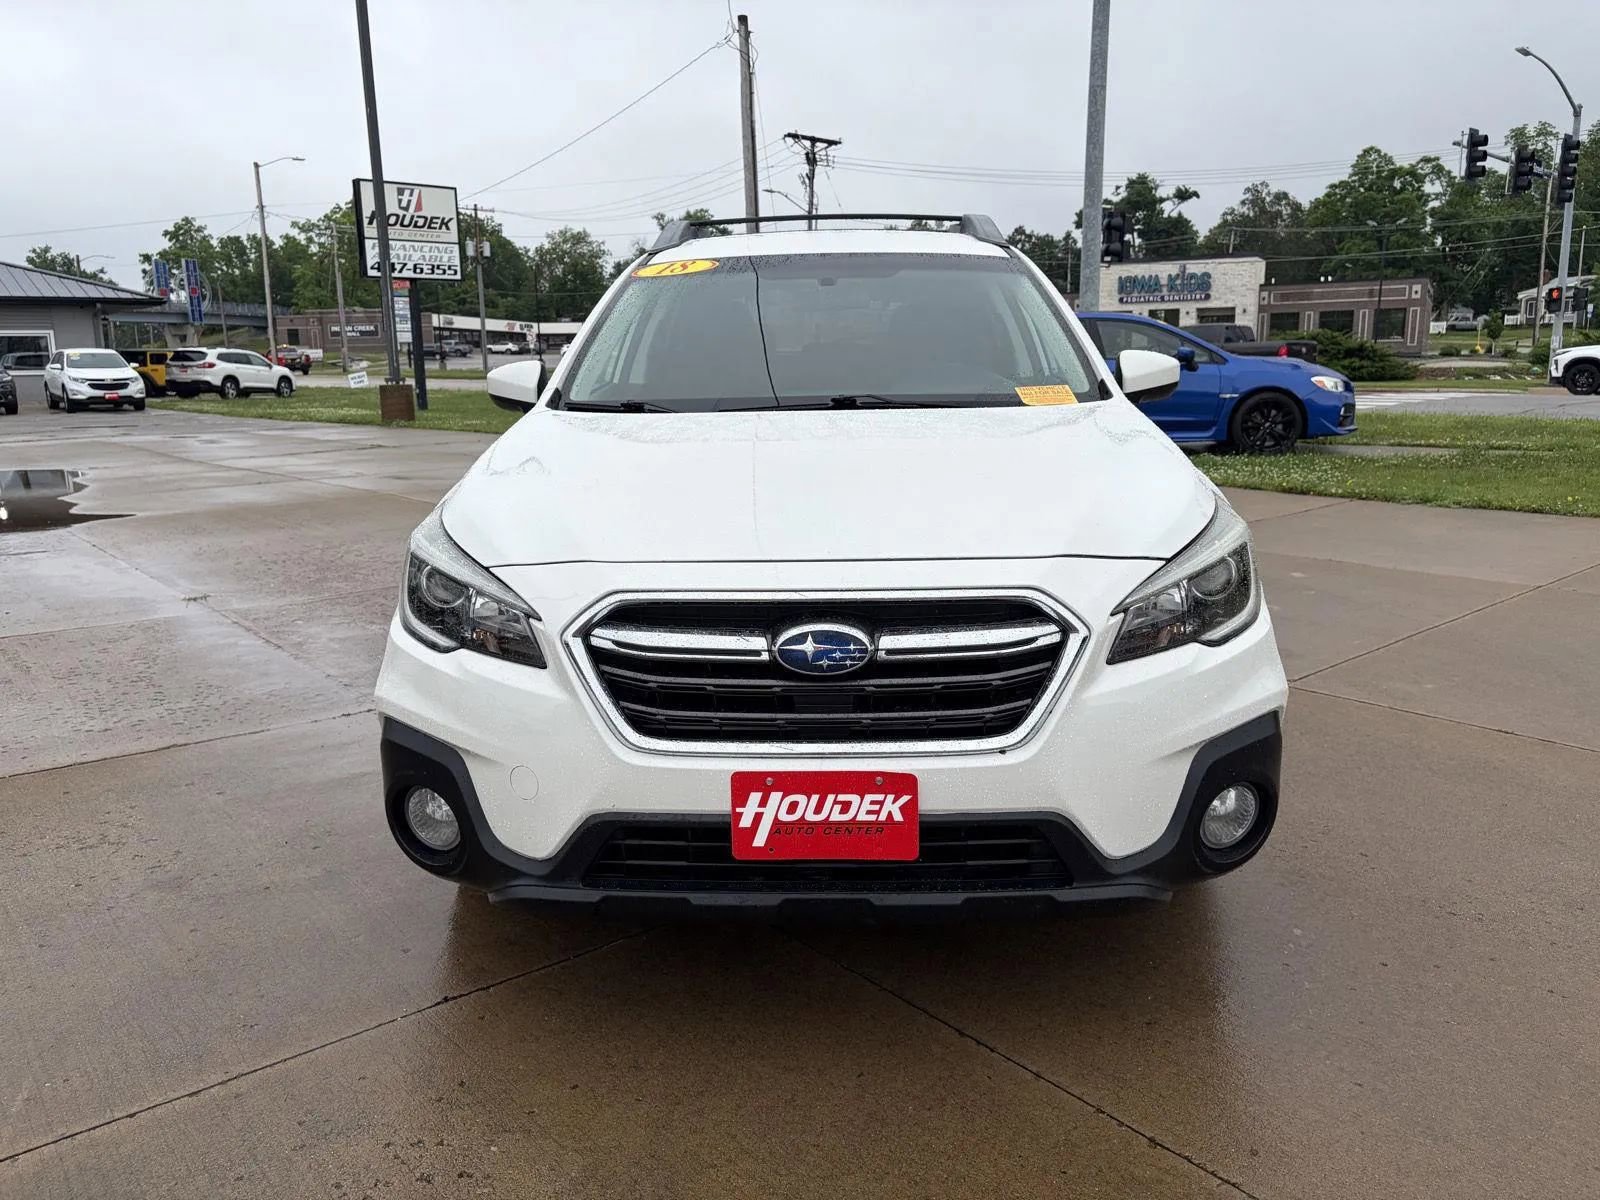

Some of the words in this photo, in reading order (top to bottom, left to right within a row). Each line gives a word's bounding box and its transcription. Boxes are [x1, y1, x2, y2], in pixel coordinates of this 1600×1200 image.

[371, 242, 454, 255] FNANCING
[371, 251, 456, 264] AAILABLE
[1117, 274, 1162, 295] IOWA
[1122, 295, 1162, 304] PEDIATRIC
[1163, 293, 1206, 302] DENTISTRY
[735, 791, 912, 847] HOUDEK
[773, 826, 815, 835] AUTO
[823, 826, 885, 836] CENTER
